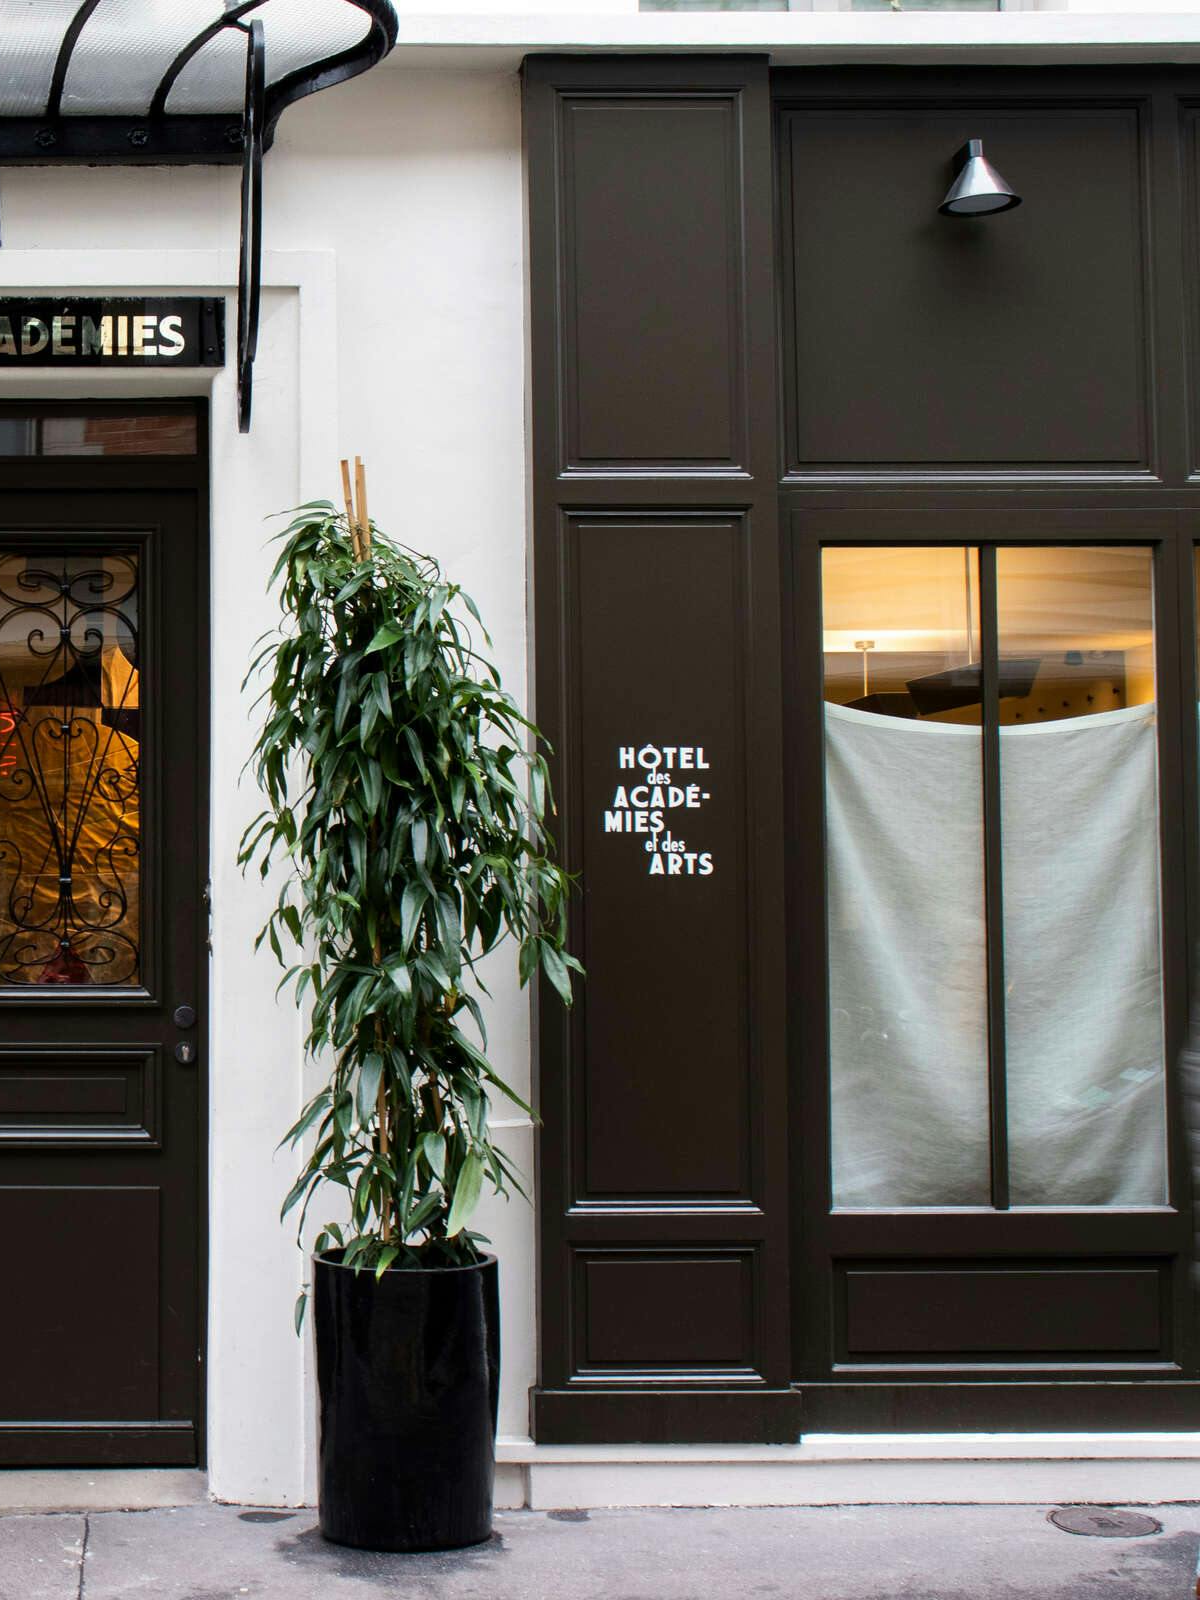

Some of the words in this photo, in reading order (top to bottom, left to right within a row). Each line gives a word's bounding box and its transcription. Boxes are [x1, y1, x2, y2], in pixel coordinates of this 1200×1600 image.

[619, 743, 710, 769] HÔTEL
[647, 766, 671, 784] des
[613, 783, 710, 808] ACADÉ-
[604, 810, 665, 833] MIES
[645, 831, 659, 852] et
[661, 831, 686, 852] des
[649, 852, 714, 876] ARTS
